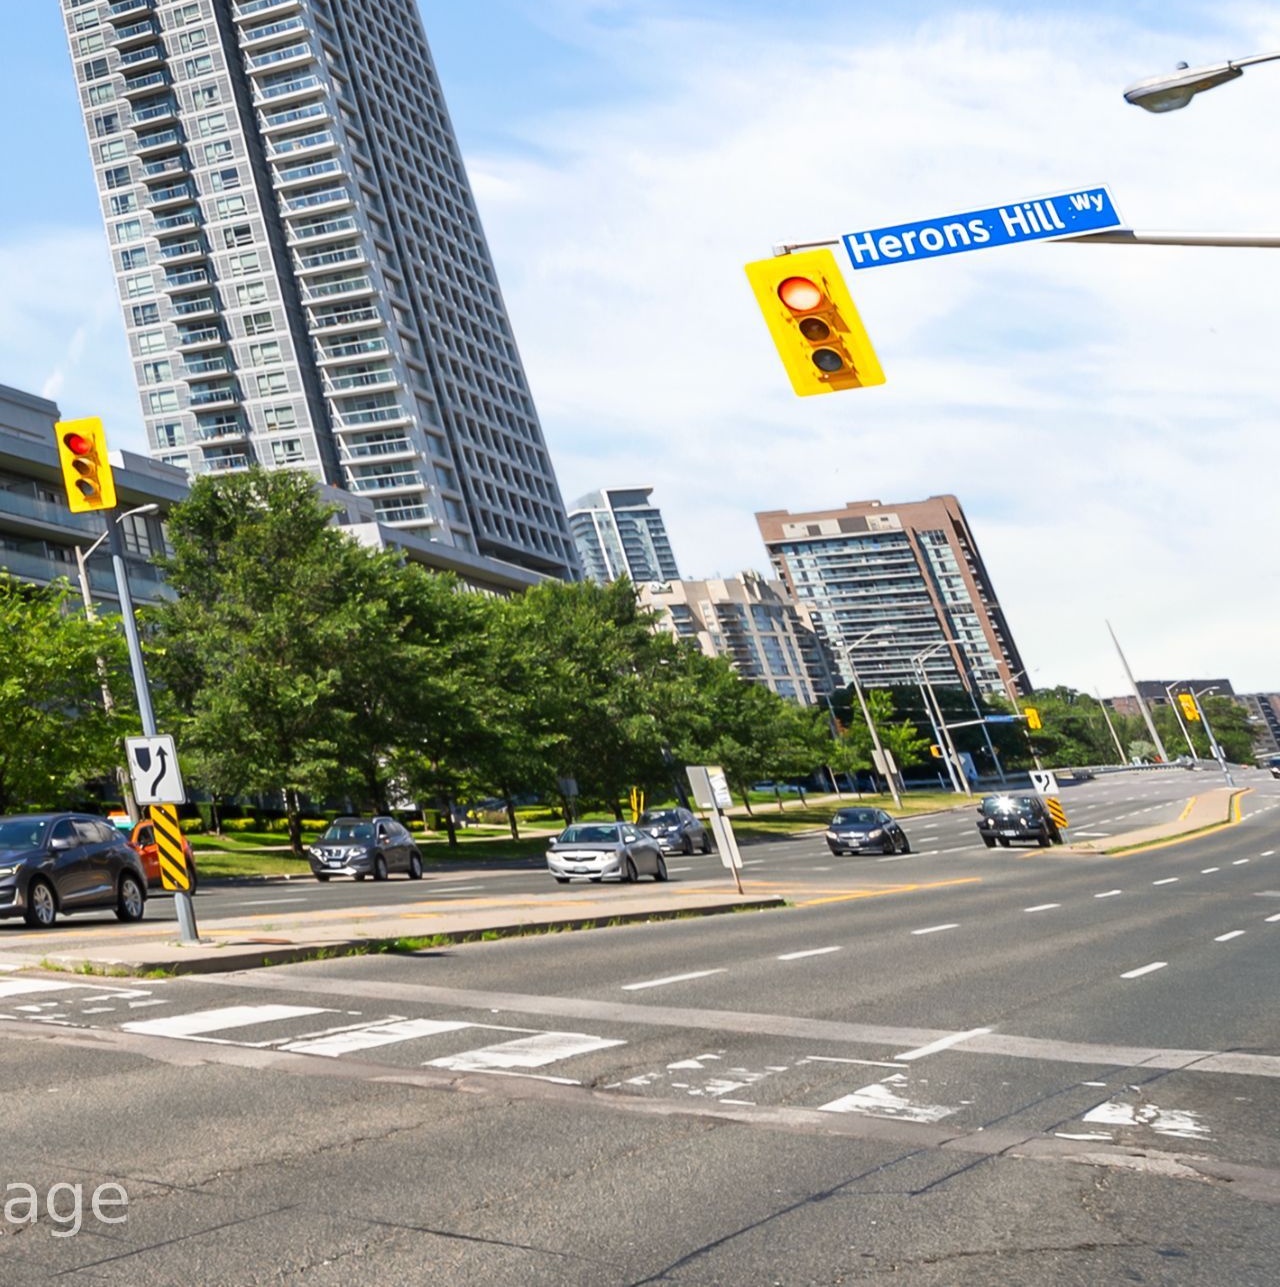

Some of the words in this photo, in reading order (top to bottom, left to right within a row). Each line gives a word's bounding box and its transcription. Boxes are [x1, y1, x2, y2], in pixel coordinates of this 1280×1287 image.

[848, 217, 991, 263] Herons
[998, 199, 1066, 238] Hill
[1069, 192, 1104, 212] Wy
